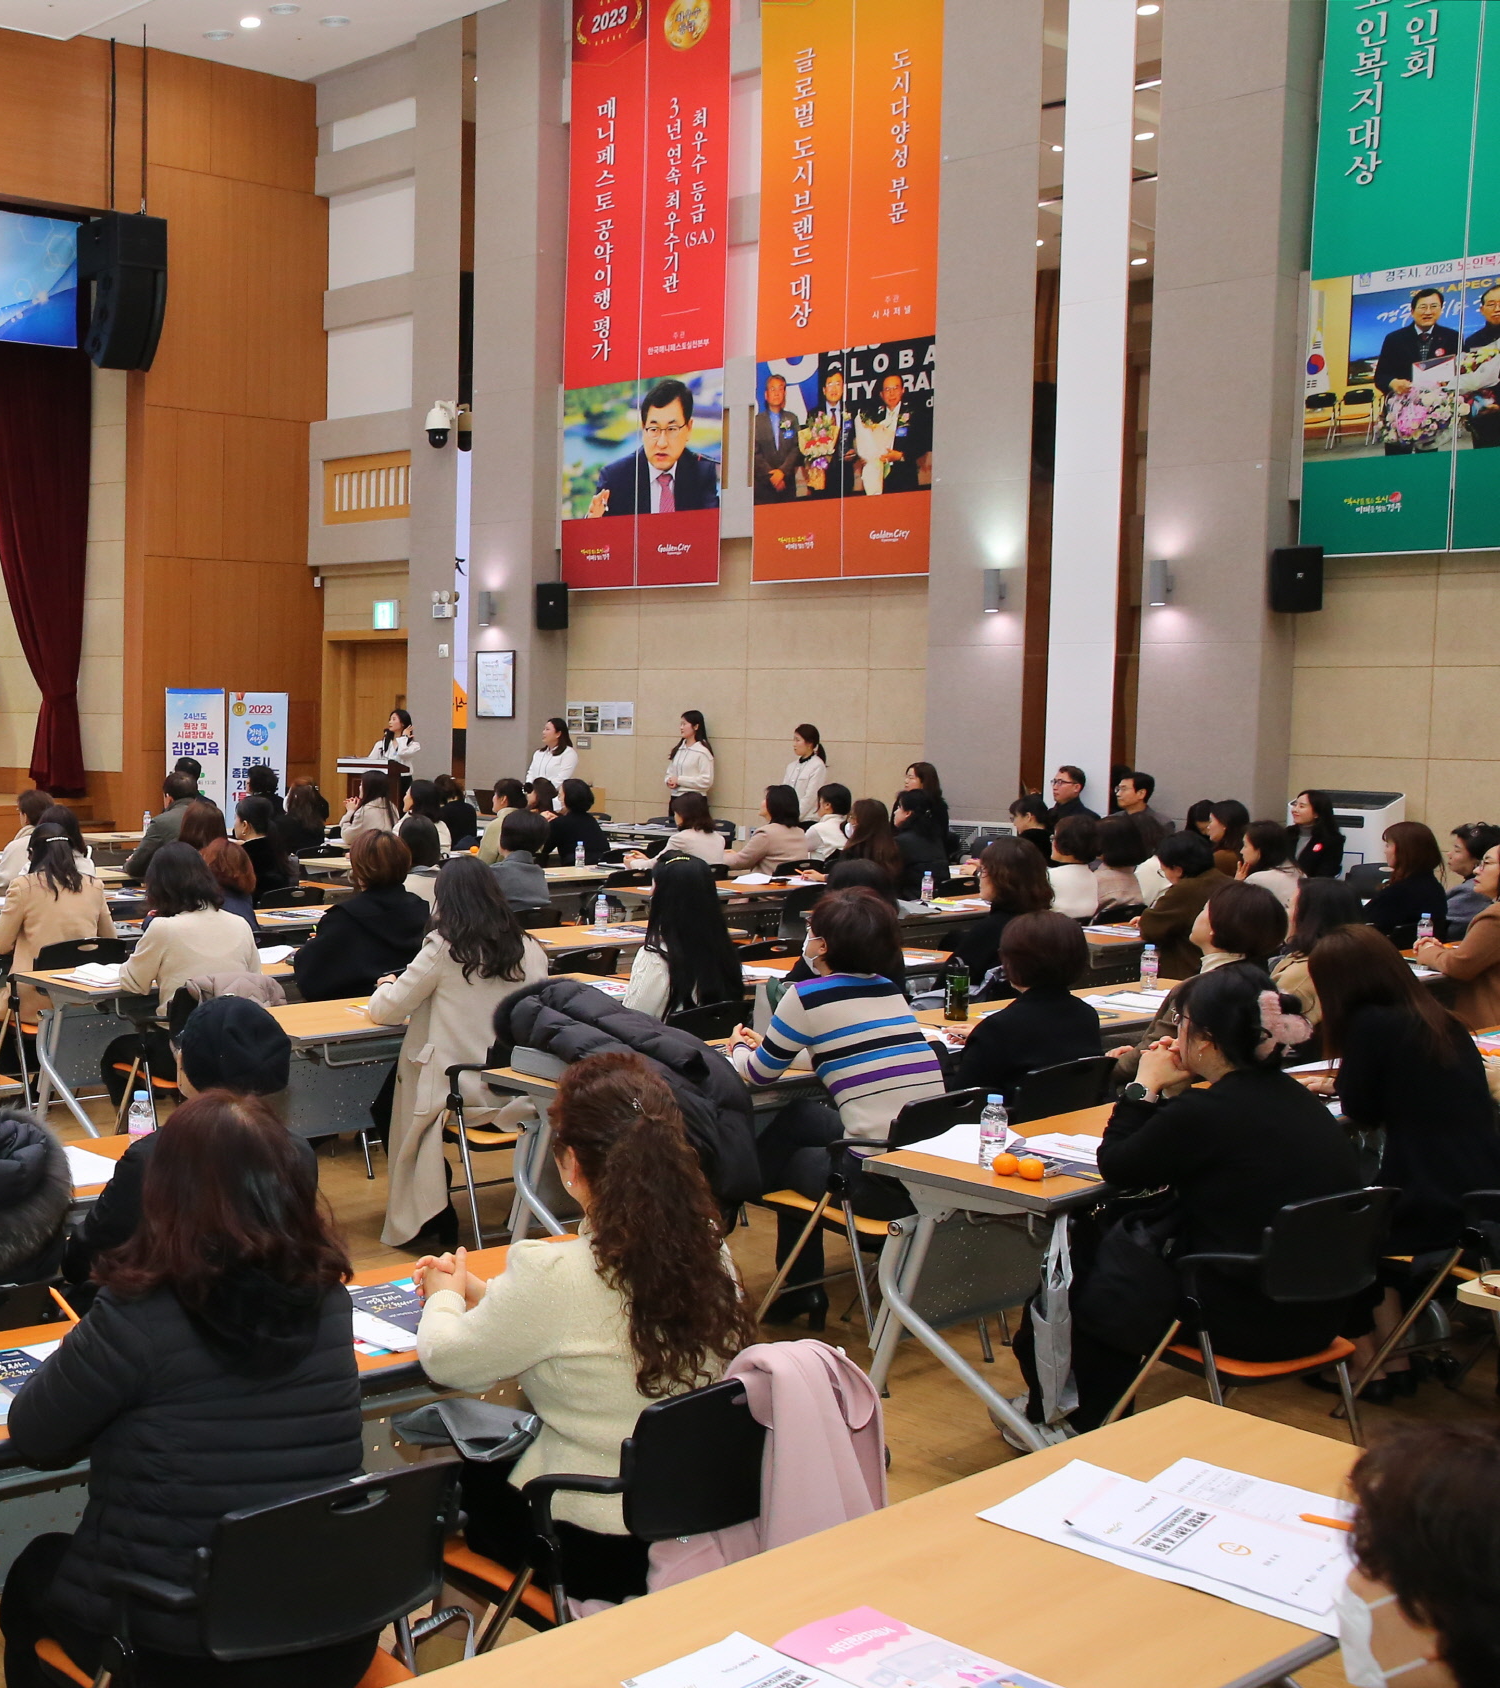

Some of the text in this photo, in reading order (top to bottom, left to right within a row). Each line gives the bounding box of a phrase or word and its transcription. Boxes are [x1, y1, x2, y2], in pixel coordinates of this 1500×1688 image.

[591, 6, 628, 34] 2023
[1400, 0, 1441, 80] 인회
[888, 48, 912, 225] 도시다양성 부문
[684, 107, 715, 248] 최우수 등급 (SA)
[789, 47, 816, 329] 글로벌 도시브랜드 대상
[662, 97, 682, 294] 3년 연속 최우수기관
[590, 97, 617, 363] 매니페스토 공약이행 평가
[1425, 263, 1453, 276] 2023
[183, 712, 207, 721] 24년도
[249, 705, 273, 714] 2023
[177, 731, 214, 740] 시설장대상
[183, 722, 208, 730] 원장 및
[172, 741, 220, 756] 집합교육
[242, 756, 270, 767] 경주시
